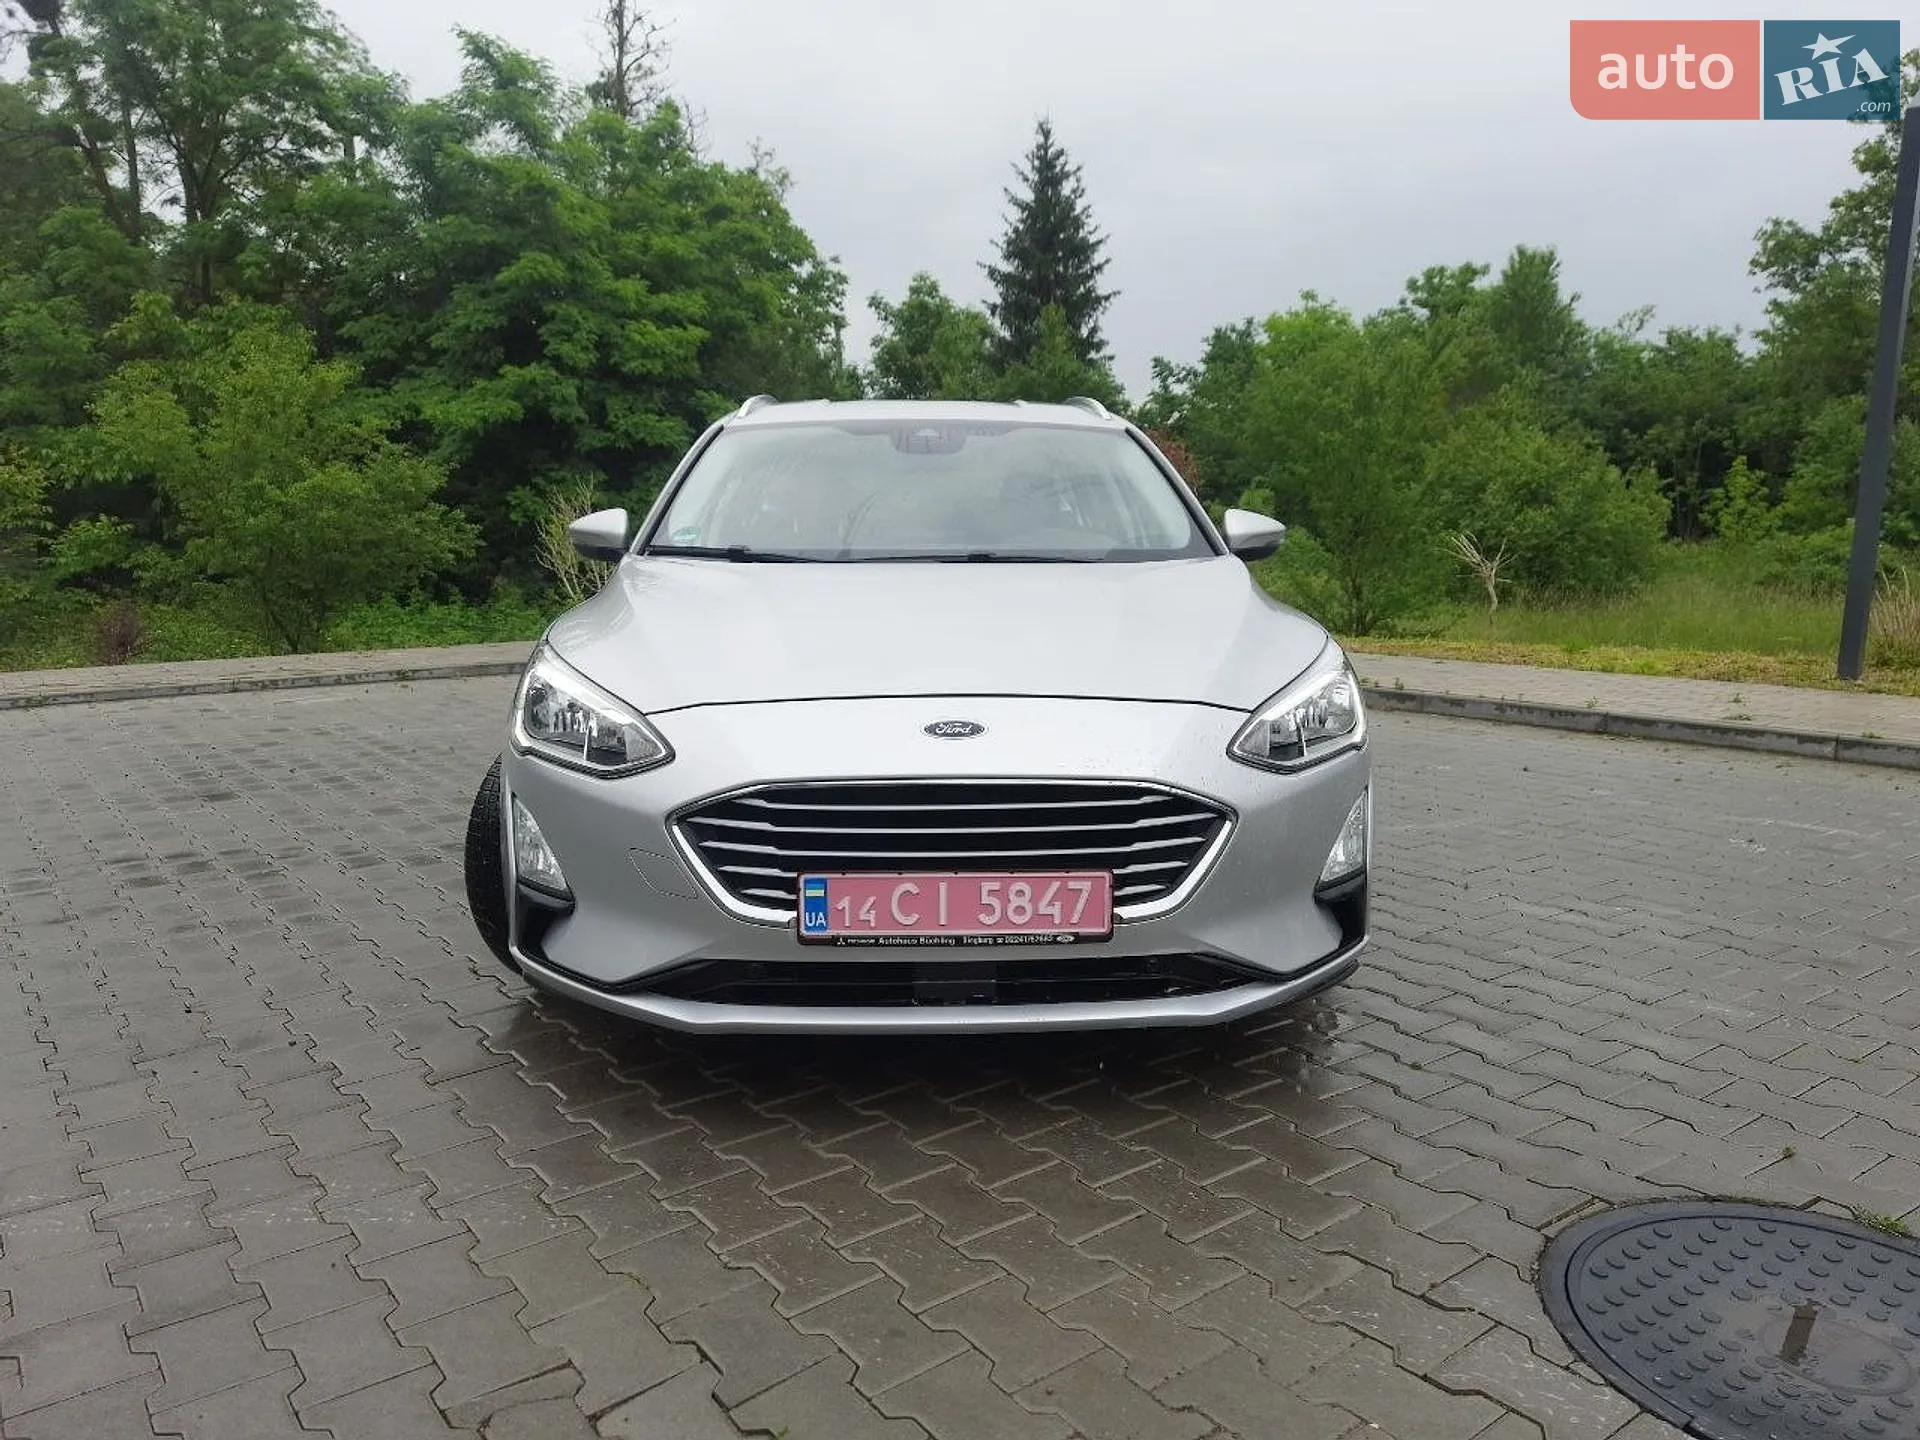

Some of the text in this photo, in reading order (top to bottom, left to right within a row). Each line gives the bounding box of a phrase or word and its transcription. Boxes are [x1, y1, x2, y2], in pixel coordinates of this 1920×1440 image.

[935, 722, 973, 734] Ford
[835, 880, 1092, 928] 14 CI 5847
[805, 911, 827, 927] UA
